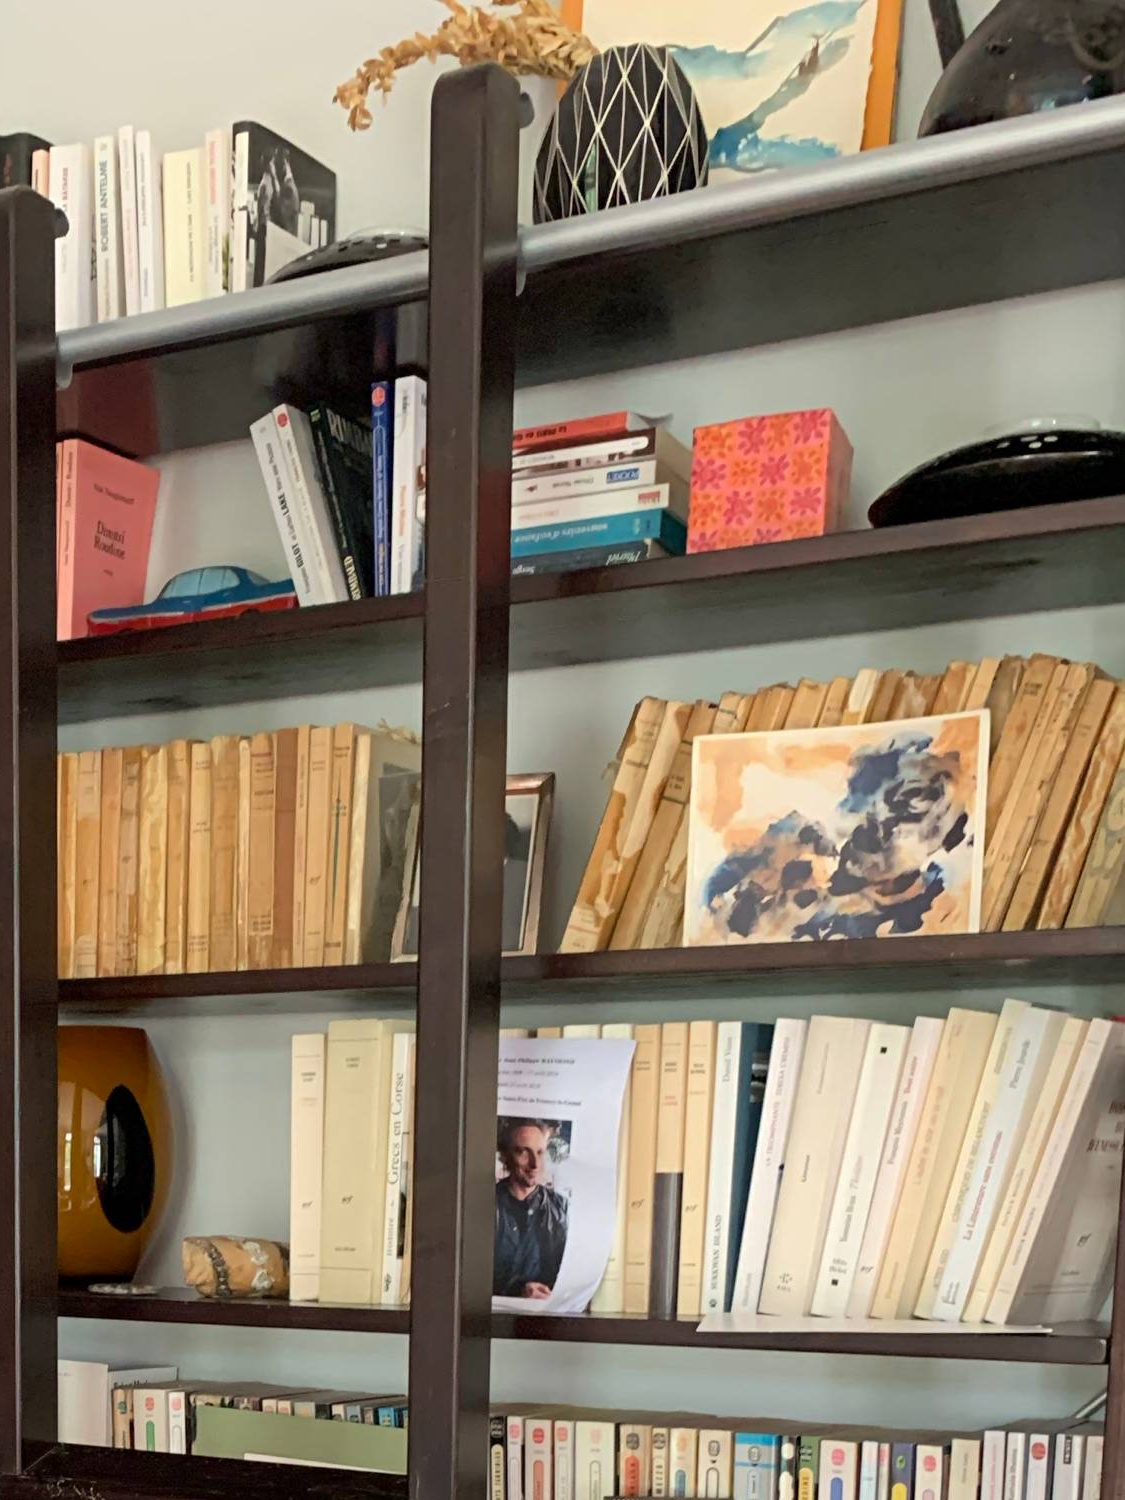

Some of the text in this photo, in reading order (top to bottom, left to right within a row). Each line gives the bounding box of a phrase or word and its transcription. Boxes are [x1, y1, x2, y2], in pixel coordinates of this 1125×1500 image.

[98, 159, 109, 251] ROBERT ANTELME
[276, 491, 290, 515] LAKE
[94, 535, 125, 560] Roudine
[97, 520, 125, 544] Dimitri
[513, 522, 608, 544] souvenirs d'enfance
[290, 541, 305, 567] GILOT
[341, 554, 363, 601] RIMBAUD
[386, 1070, 405, 1185] Grecs en Corse
[962, 1227, 974, 1241] La
[980, 1164, 994, 1184] sans
[1007, 1064, 1024, 1090] Pierre
[709, 1213, 722, 1290] SUKKWAN ISLAND
